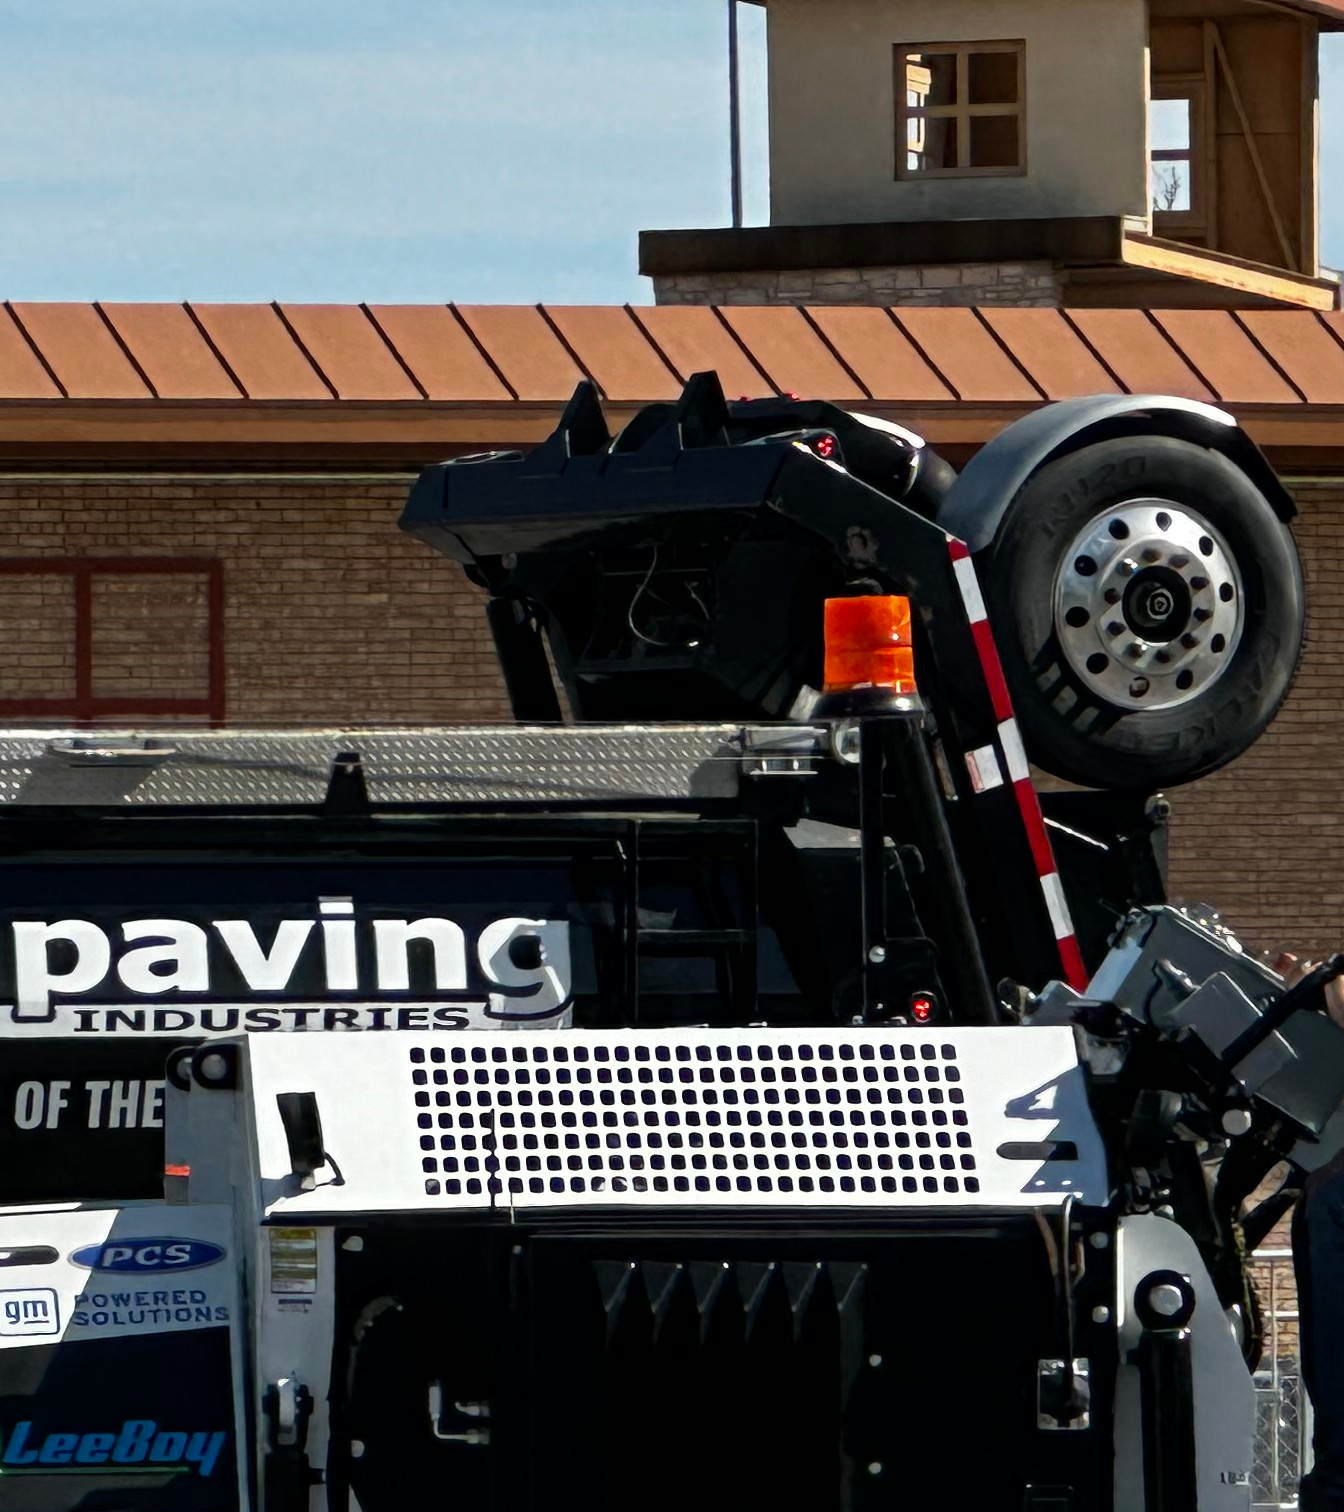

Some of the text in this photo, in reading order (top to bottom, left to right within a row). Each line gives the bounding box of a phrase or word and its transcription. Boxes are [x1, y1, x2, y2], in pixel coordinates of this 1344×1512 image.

[12, 895, 572, 1021] paving
[73, 1007, 471, 1033] INDUSTRIES
[15, 1079, 68, 1130] OF
[86, 1079, 164, 1128] THE
[101, 1244, 192, 1267] PCS
[75, 1289, 207, 1308] POWERED
[4, 1300, 48, 1325] gm
[73, 1306, 230, 1326] SOLUTIONS
[4, 1418, 227, 1477] LeeBoy
